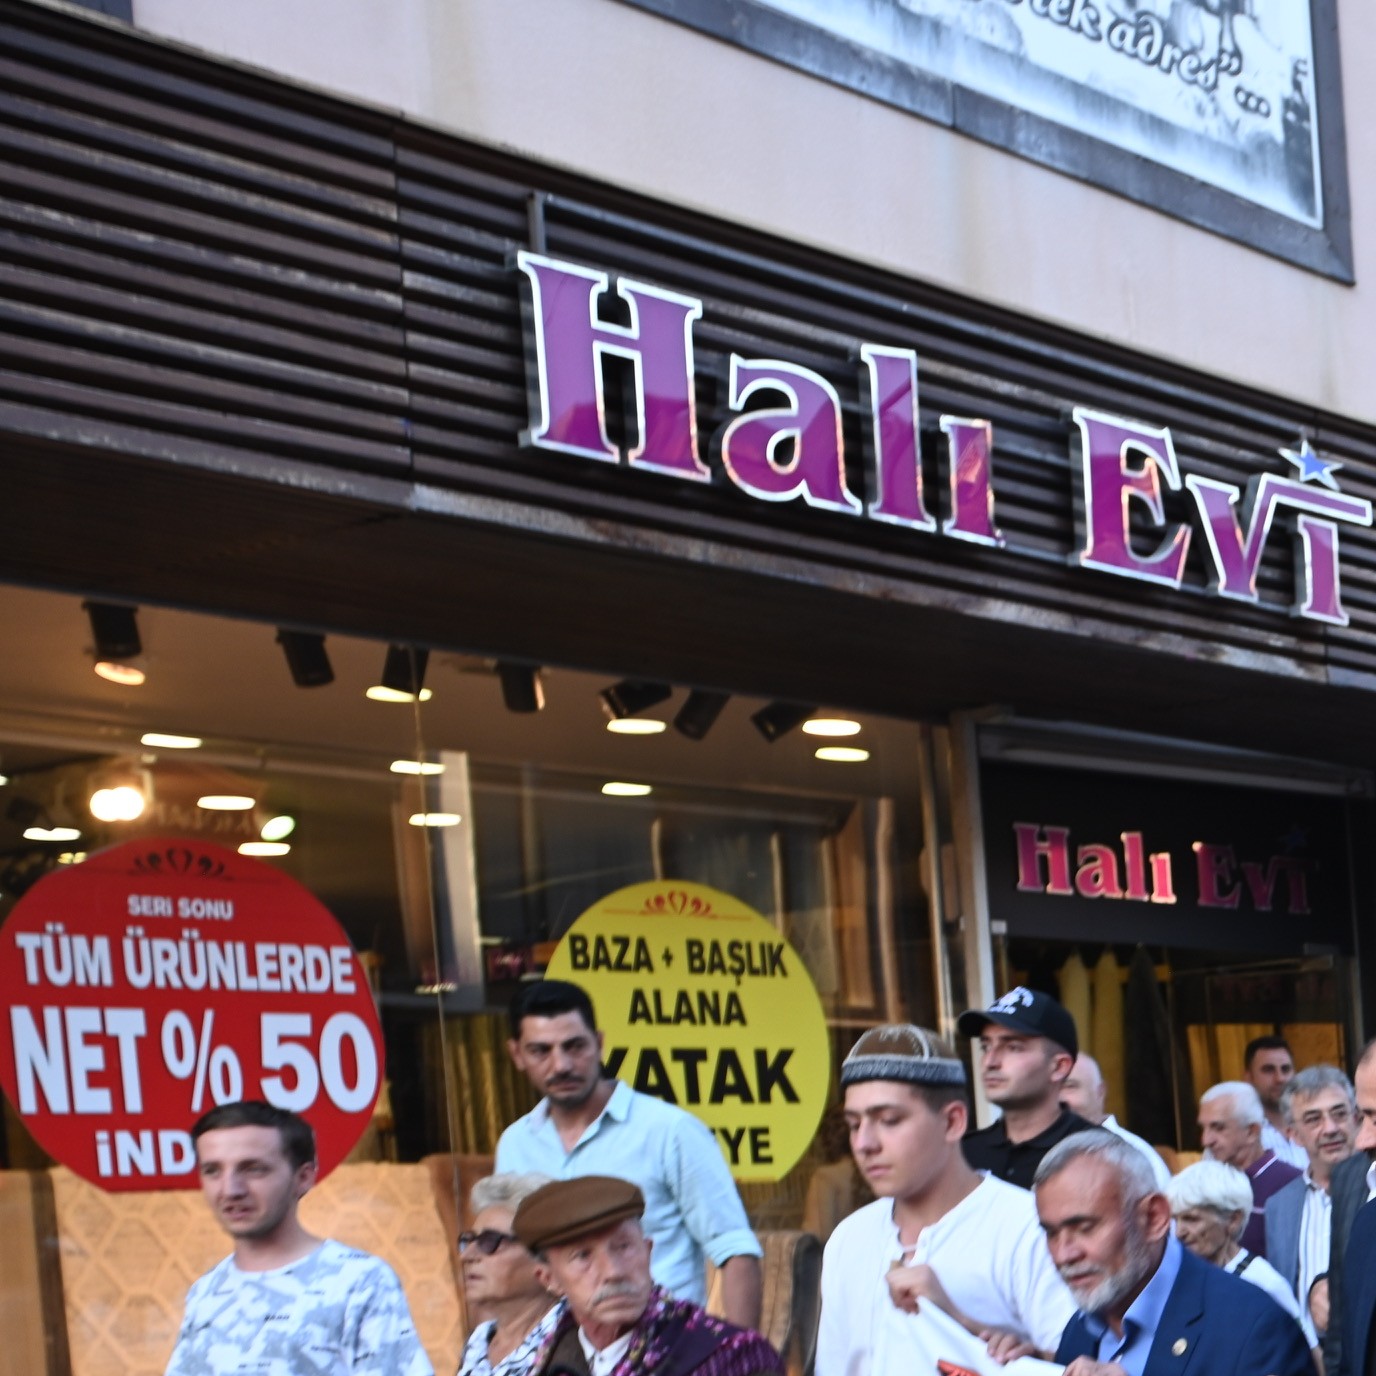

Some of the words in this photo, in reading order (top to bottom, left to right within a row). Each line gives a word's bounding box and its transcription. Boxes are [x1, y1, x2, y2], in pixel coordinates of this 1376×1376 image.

[516, 249, 1005, 548] Halı
[1013, 822, 1177, 904] Halı
[178, 897, 233, 921] SONU
[16, 923, 113, 988] TÜM
[122, 927, 356, 994] ÜRÜNLERDE
[568, 934, 654, 973] BAZA
[685, 938, 789, 985] BAŞLIK
[627, 988, 747, 1026] ALANA
[10, 1006, 146, 1115] NET
[161, 1008, 243, 1112] %
[260, 1012, 378, 1114] 50
